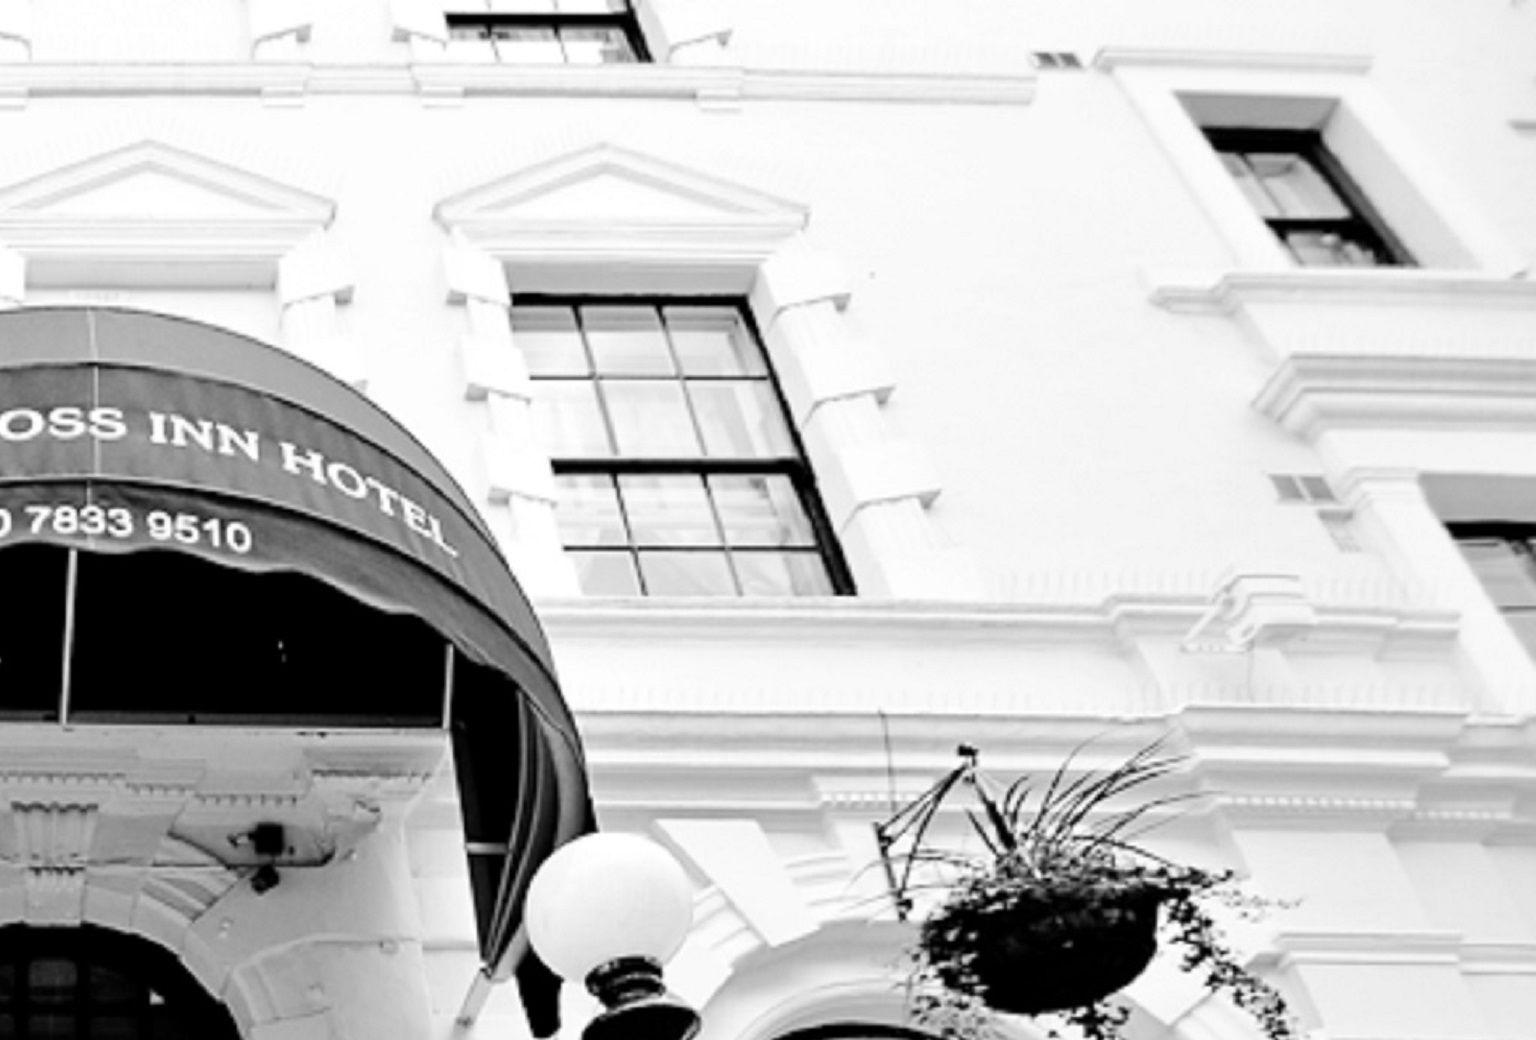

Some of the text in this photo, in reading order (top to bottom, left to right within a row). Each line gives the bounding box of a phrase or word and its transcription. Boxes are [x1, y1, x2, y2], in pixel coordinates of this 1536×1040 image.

[26, 506, 133, 536] 7833
[147, 511, 252, 553] 9510
[149, 411, 259, 462] INN
[280, 442, 459, 557] HOTEL
